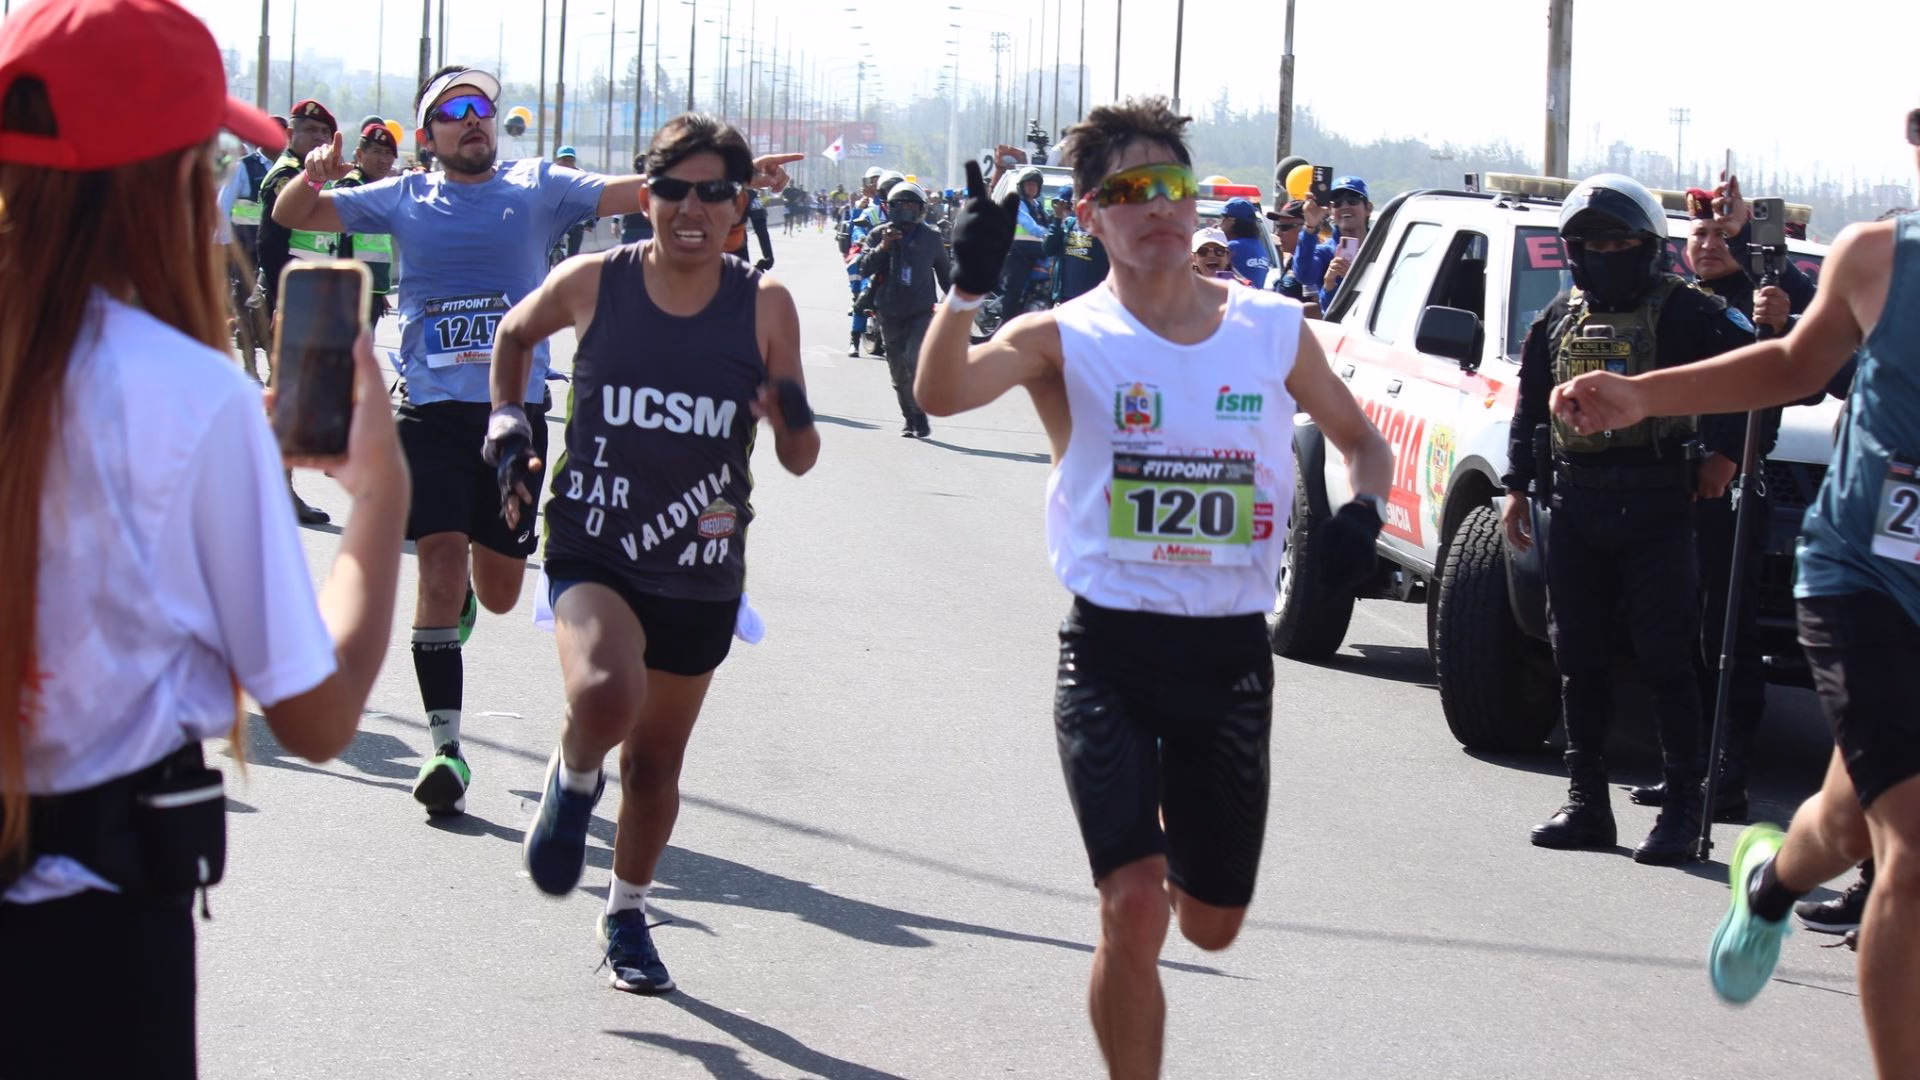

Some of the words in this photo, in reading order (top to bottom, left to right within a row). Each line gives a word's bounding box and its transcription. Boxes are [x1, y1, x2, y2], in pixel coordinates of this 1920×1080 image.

[441, 298, 492, 312] FITPOINT
[603, 384, 737, 439] UCSM
[1216, 385, 1264, 413] ism
[1143, 462, 1225, 478] FITPOINT
[620, 463, 732, 562] VALDIVIA
[1126, 486, 1237, 539] 120
[678, 537, 729, 567] AQP
